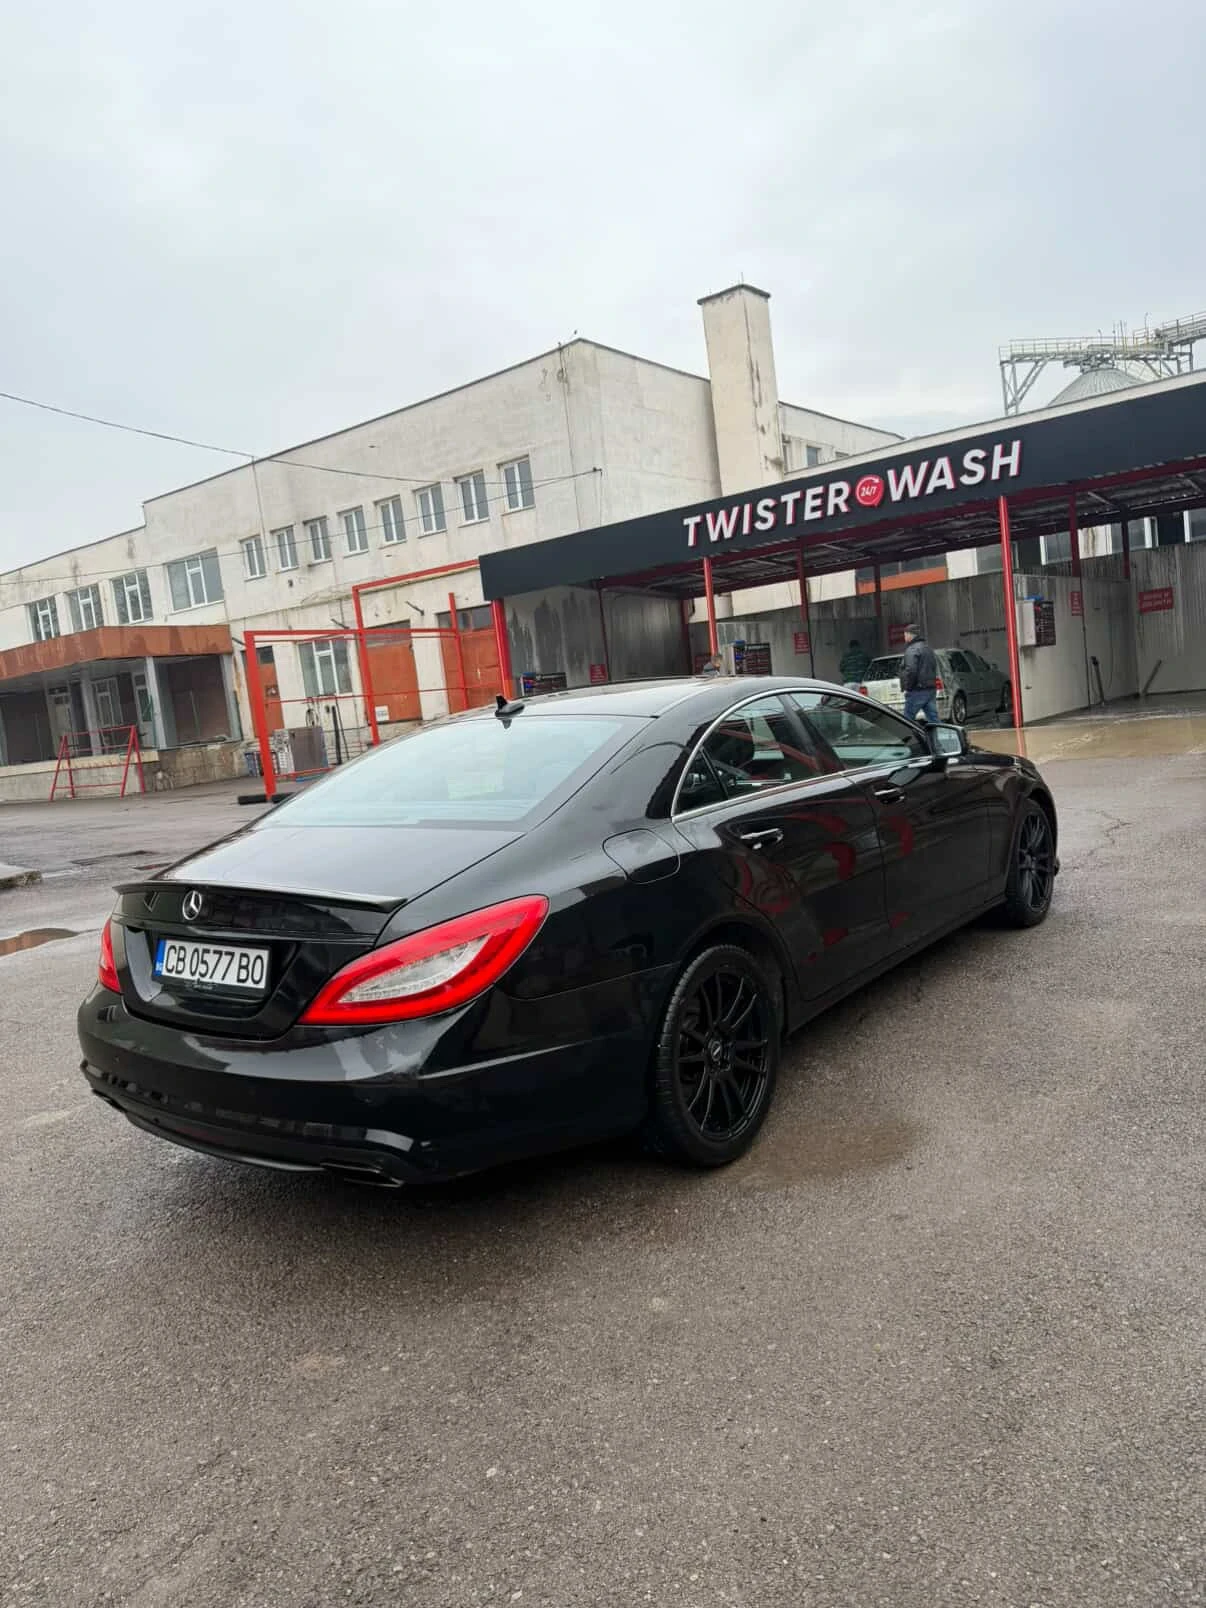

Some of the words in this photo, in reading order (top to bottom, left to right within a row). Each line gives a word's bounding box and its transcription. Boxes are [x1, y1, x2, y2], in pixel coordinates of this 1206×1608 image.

[684, 481, 851, 547] TWISTER
[887, 440, 1022, 502] WASH
[860, 486, 877, 497] 24/7
[165, 945, 187, 974] CB
[189, 947, 235, 980] 0577
